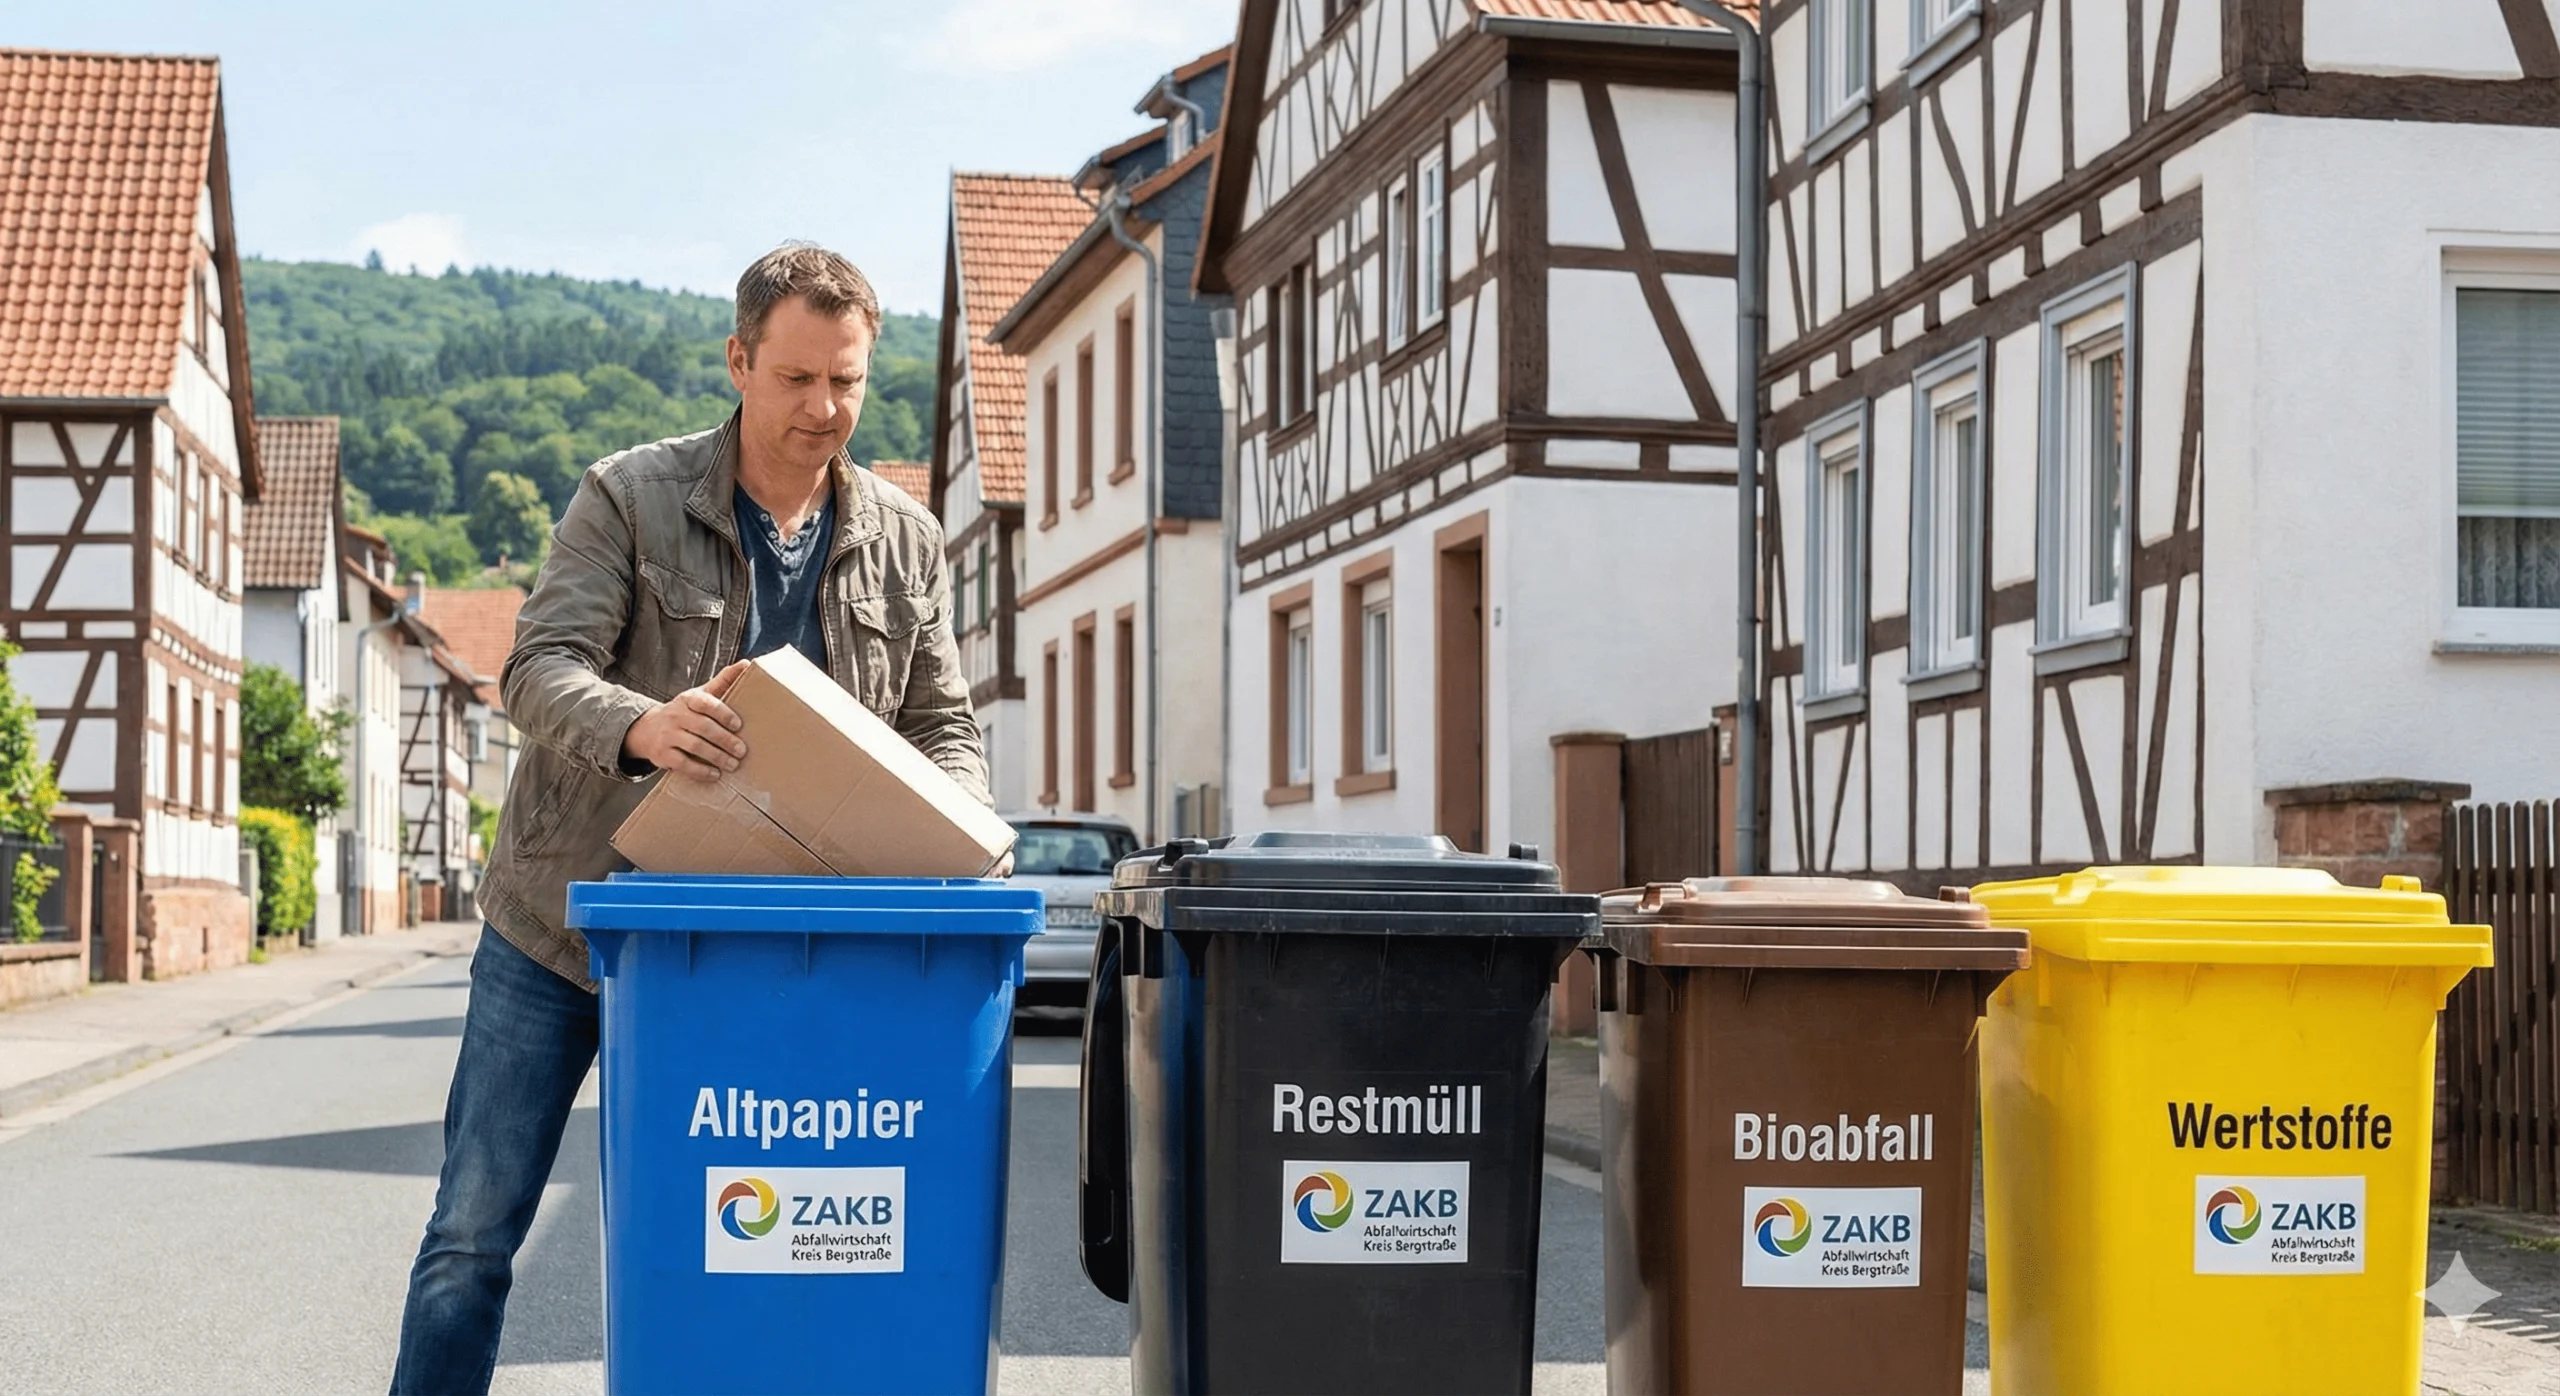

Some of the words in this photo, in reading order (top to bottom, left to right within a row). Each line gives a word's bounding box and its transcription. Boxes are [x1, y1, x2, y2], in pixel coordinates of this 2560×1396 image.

[688, 1087, 923, 1150] Altpapier
[1273, 1083, 1481, 1134] Restmüll
[1734, 1113, 1934, 1161] Bioabfall
[2167, 1101, 2392, 1150] Wertstoffe
[791, 1196, 893, 1226] ZAKB
[1364, 1189, 1458, 1218] ZAKB
[2271, 1203, 2356, 1230] ZAKB
[791, 1233, 892, 1246] Abfallwirtschaft
[1822, 1214, 1911, 1243] ZAKB
[792, 1248, 822, 1261] Kreis
[825, 1247, 892, 1264] Bergstraße
[1364, 1239, 1393, 1252] Kreis
[1822, 1249, 1910, 1262] Abfallwirtschaft
[2271, 1251, 2297, 1263] Kreis
[1822, 1264, 1849, 1276] Kreis
